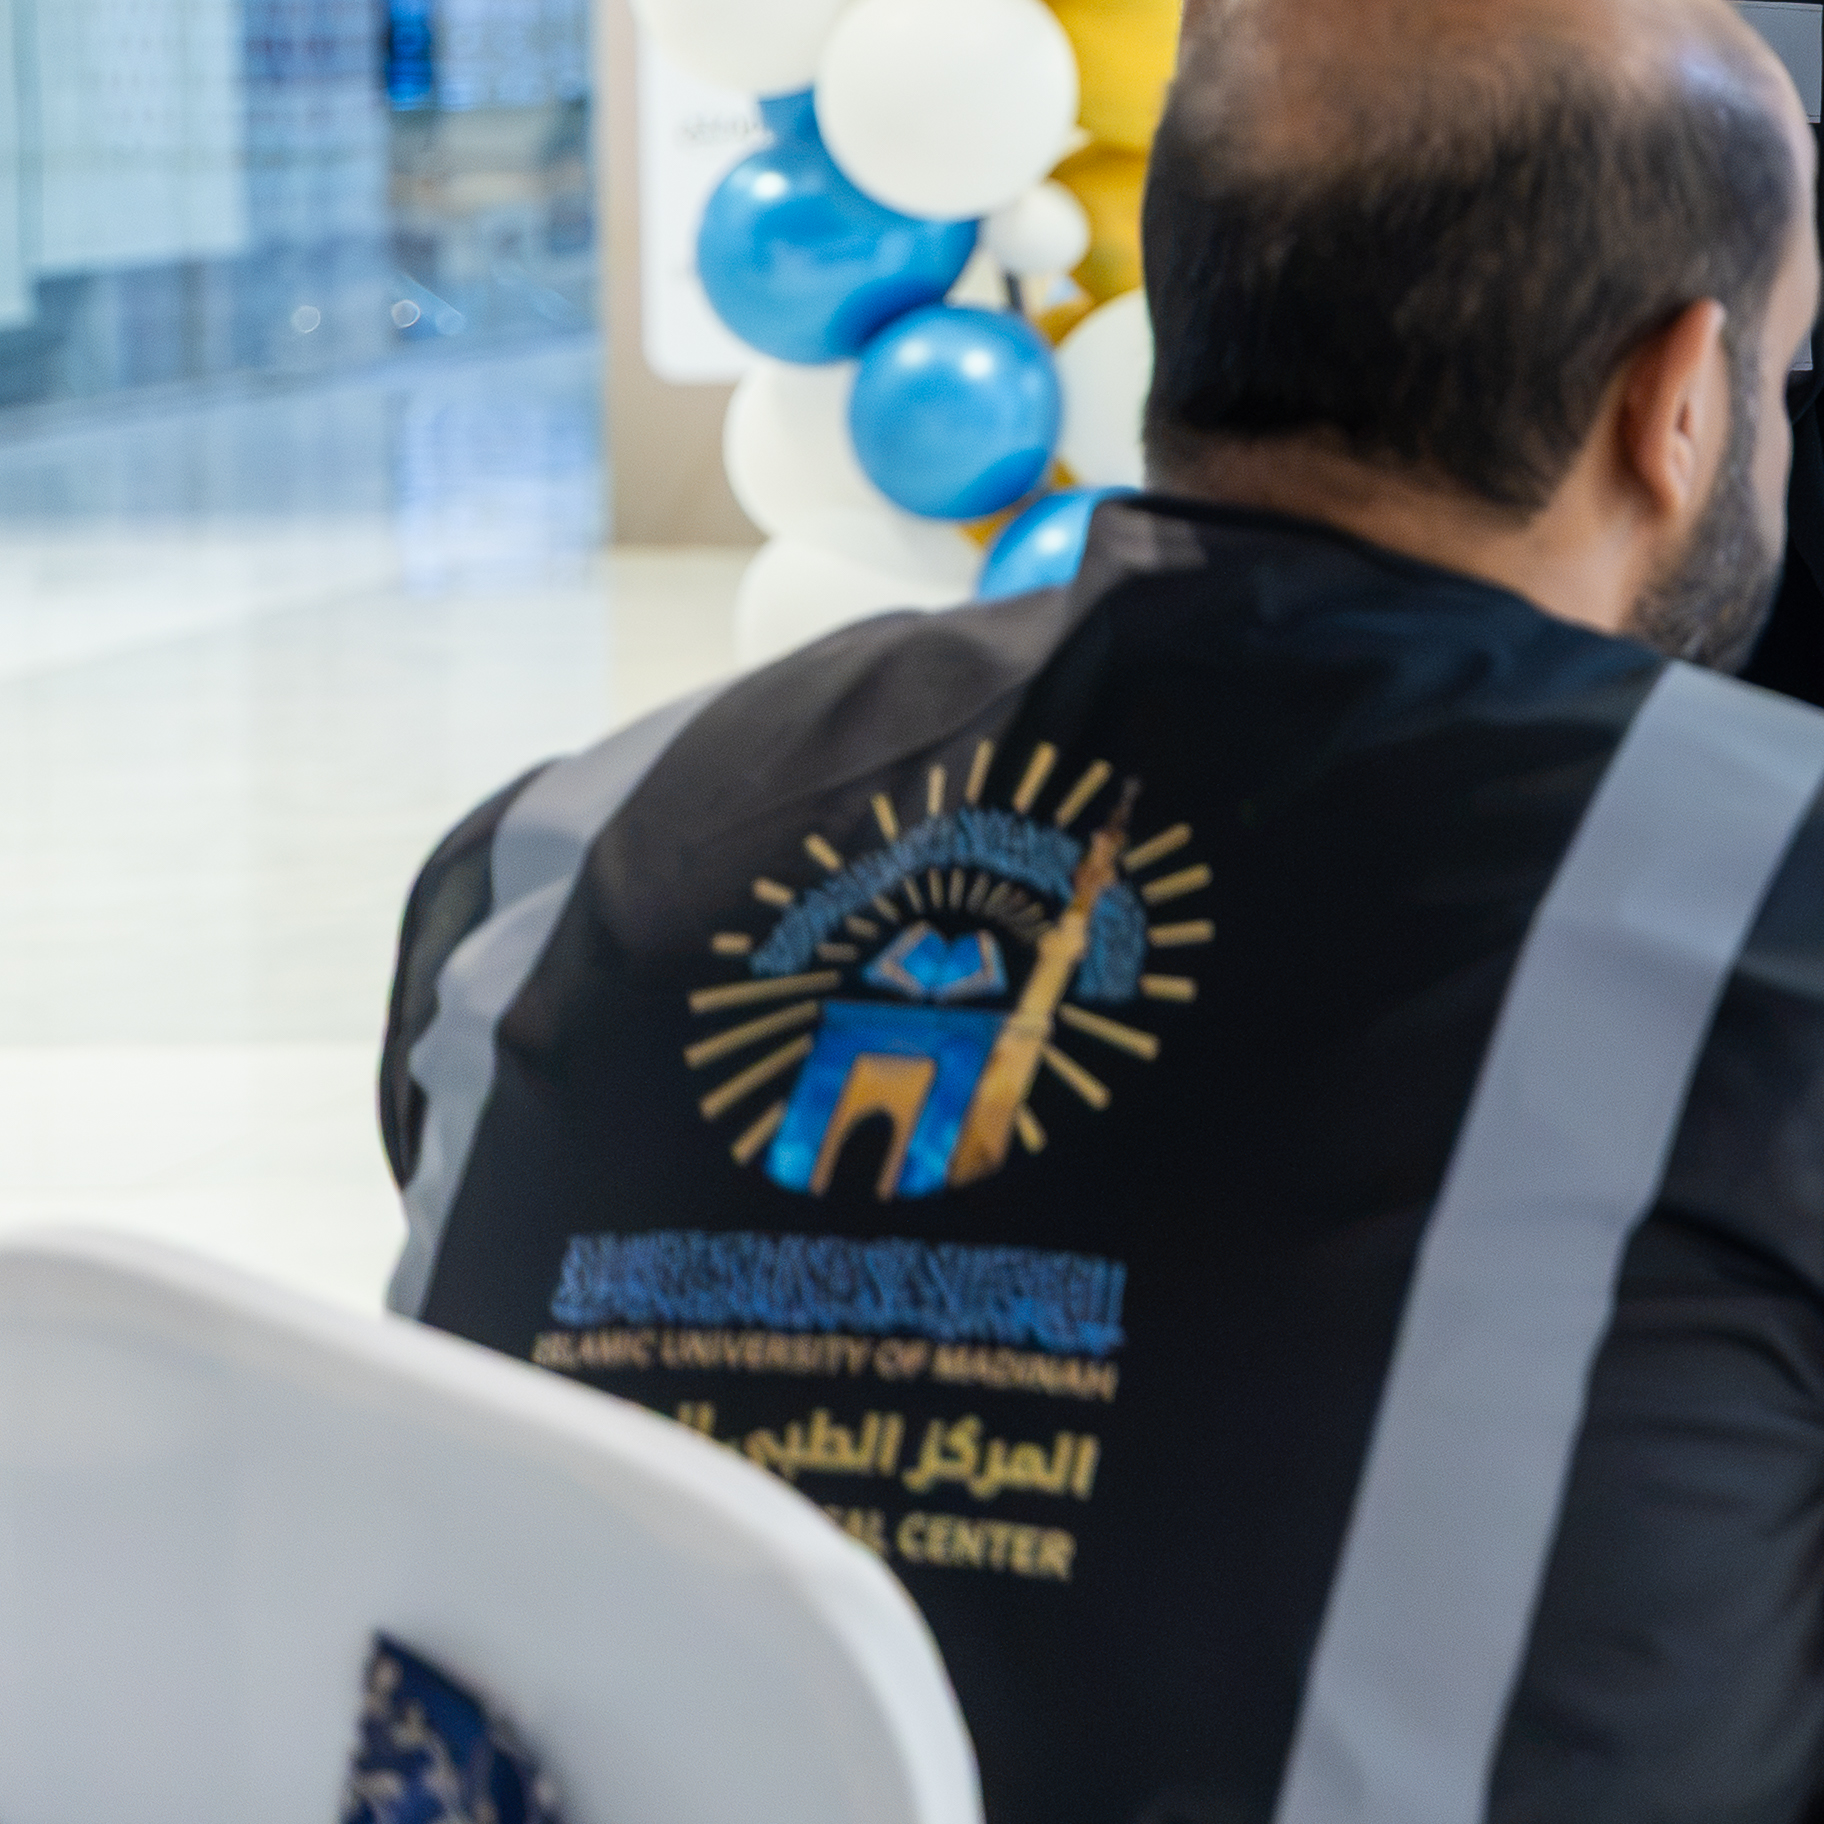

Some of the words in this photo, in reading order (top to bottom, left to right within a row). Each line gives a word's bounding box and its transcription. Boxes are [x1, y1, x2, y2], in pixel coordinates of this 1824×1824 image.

[660, 1331, 867, 1375] UNIVERSITY
[873, 1337, 930, 1379] OF
[904, 1414, 1099, 1501] المركز
[897, 1513, 1076, 1580] CENTER
